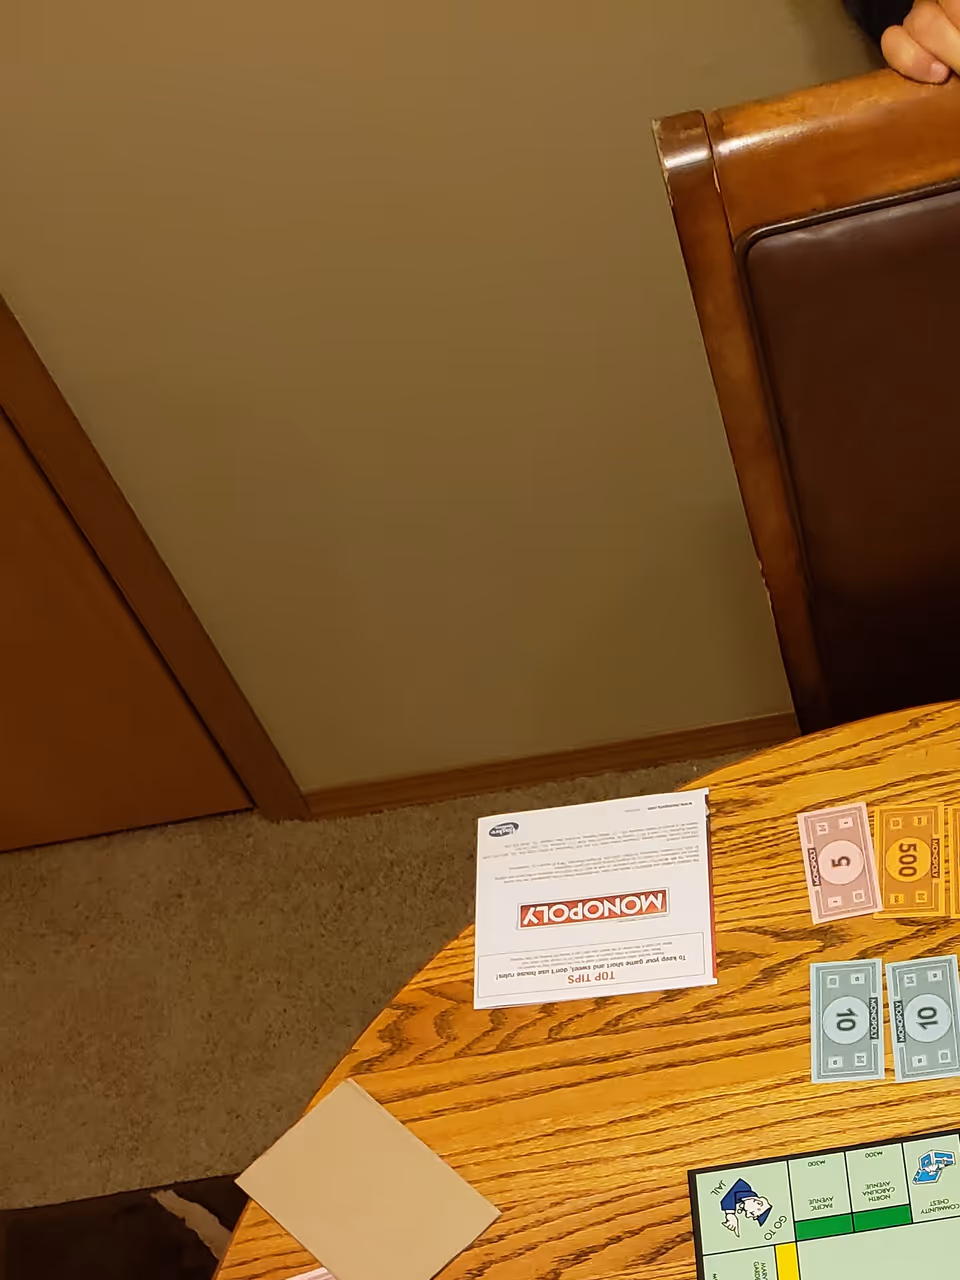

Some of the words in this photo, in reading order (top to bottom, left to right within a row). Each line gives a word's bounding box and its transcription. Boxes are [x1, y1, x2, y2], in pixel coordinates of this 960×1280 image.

[831, 856, 851, 868] 5
[899, 842, 918, 877] 500
[932, 839, 940, 878] MONOPOLY
[808, 849, 821, 886] MONOPOLY
[522, 892, 664, 925] MONOPOLY
[607, 961, 624, 969] short
[625, 959, 644, 967] game
[642, 957, 658, 965] your
[568, 974, 591, 985] TIPS
[594, 971, 615, 981] TOP
[836, 1008, 859, 1031] 10
[869, 997, 878, 1039] MONOPOLY
[894, 1000, 906, 1043] MONOPOLY
[917, 1006, 938, 1030] 10
[709, 1179, 727, 1196] JAIL
[861, 1188, 896, 1198] CAROLINA
[920, 1202, 960, 1214] COMMUNITY
[773, 1215, 787, 1231] GO
[764, 1227, 777, 1240] TO
